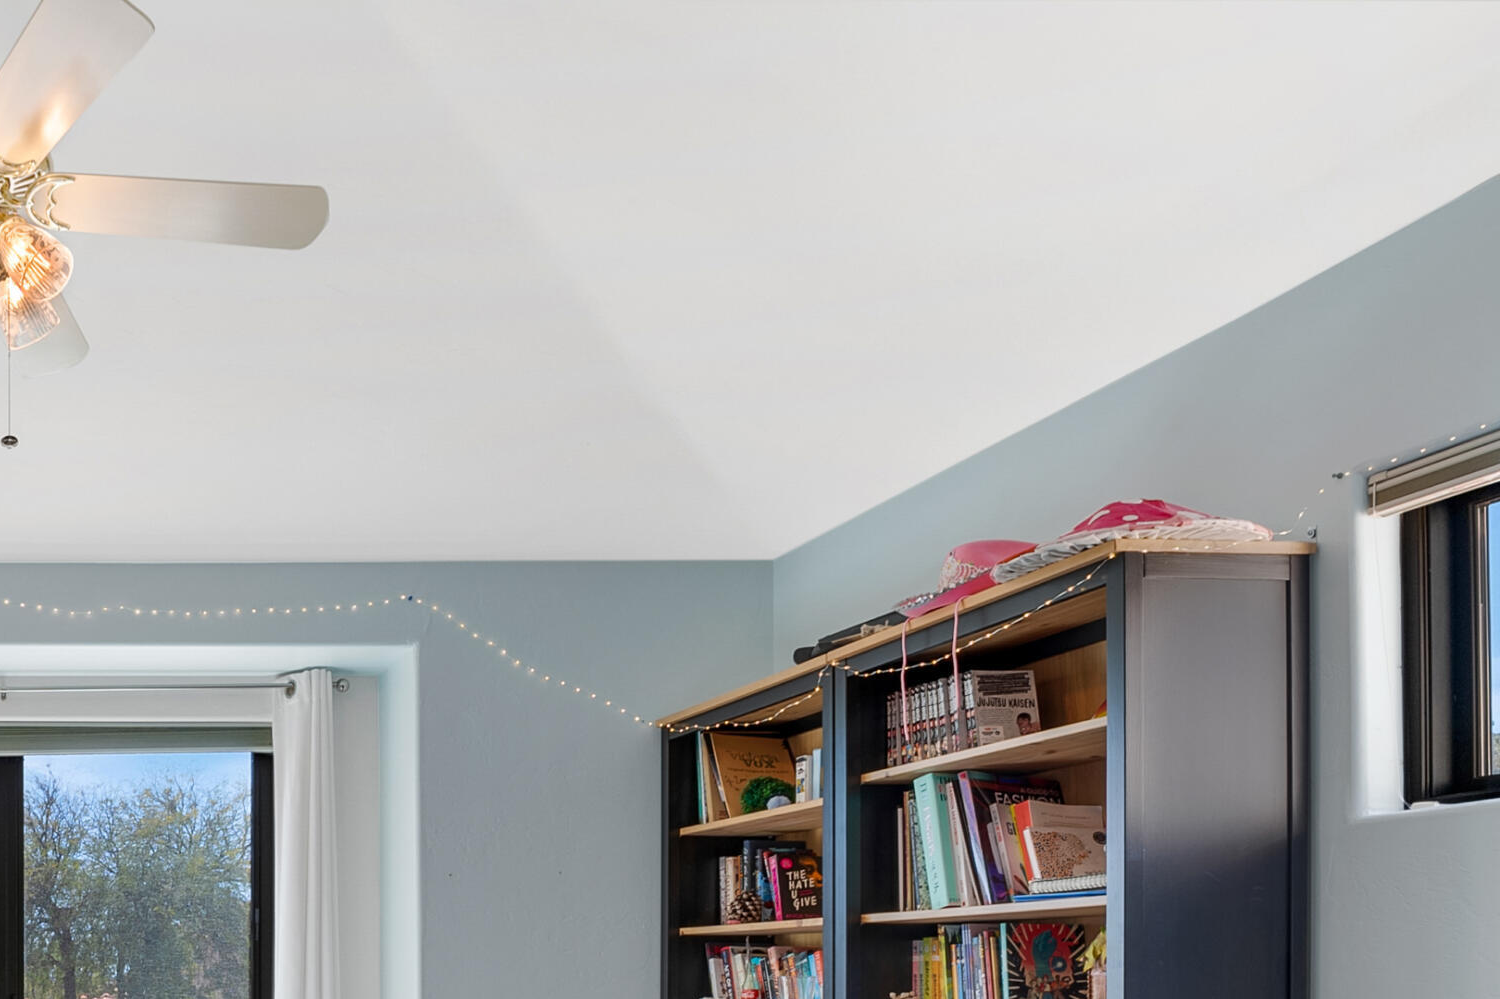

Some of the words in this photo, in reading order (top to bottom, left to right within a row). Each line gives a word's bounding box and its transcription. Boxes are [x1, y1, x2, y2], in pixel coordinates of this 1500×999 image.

[977, 697, 1007, 707] JUJUTSU
[1008, 698, 1035, 708] KAISEN
[786, 869, 806, 881] THE
[788, 878, 815, 890] HATE
[791, 890, 798, 900] U
[793, 896, 817, 911] GIVE
